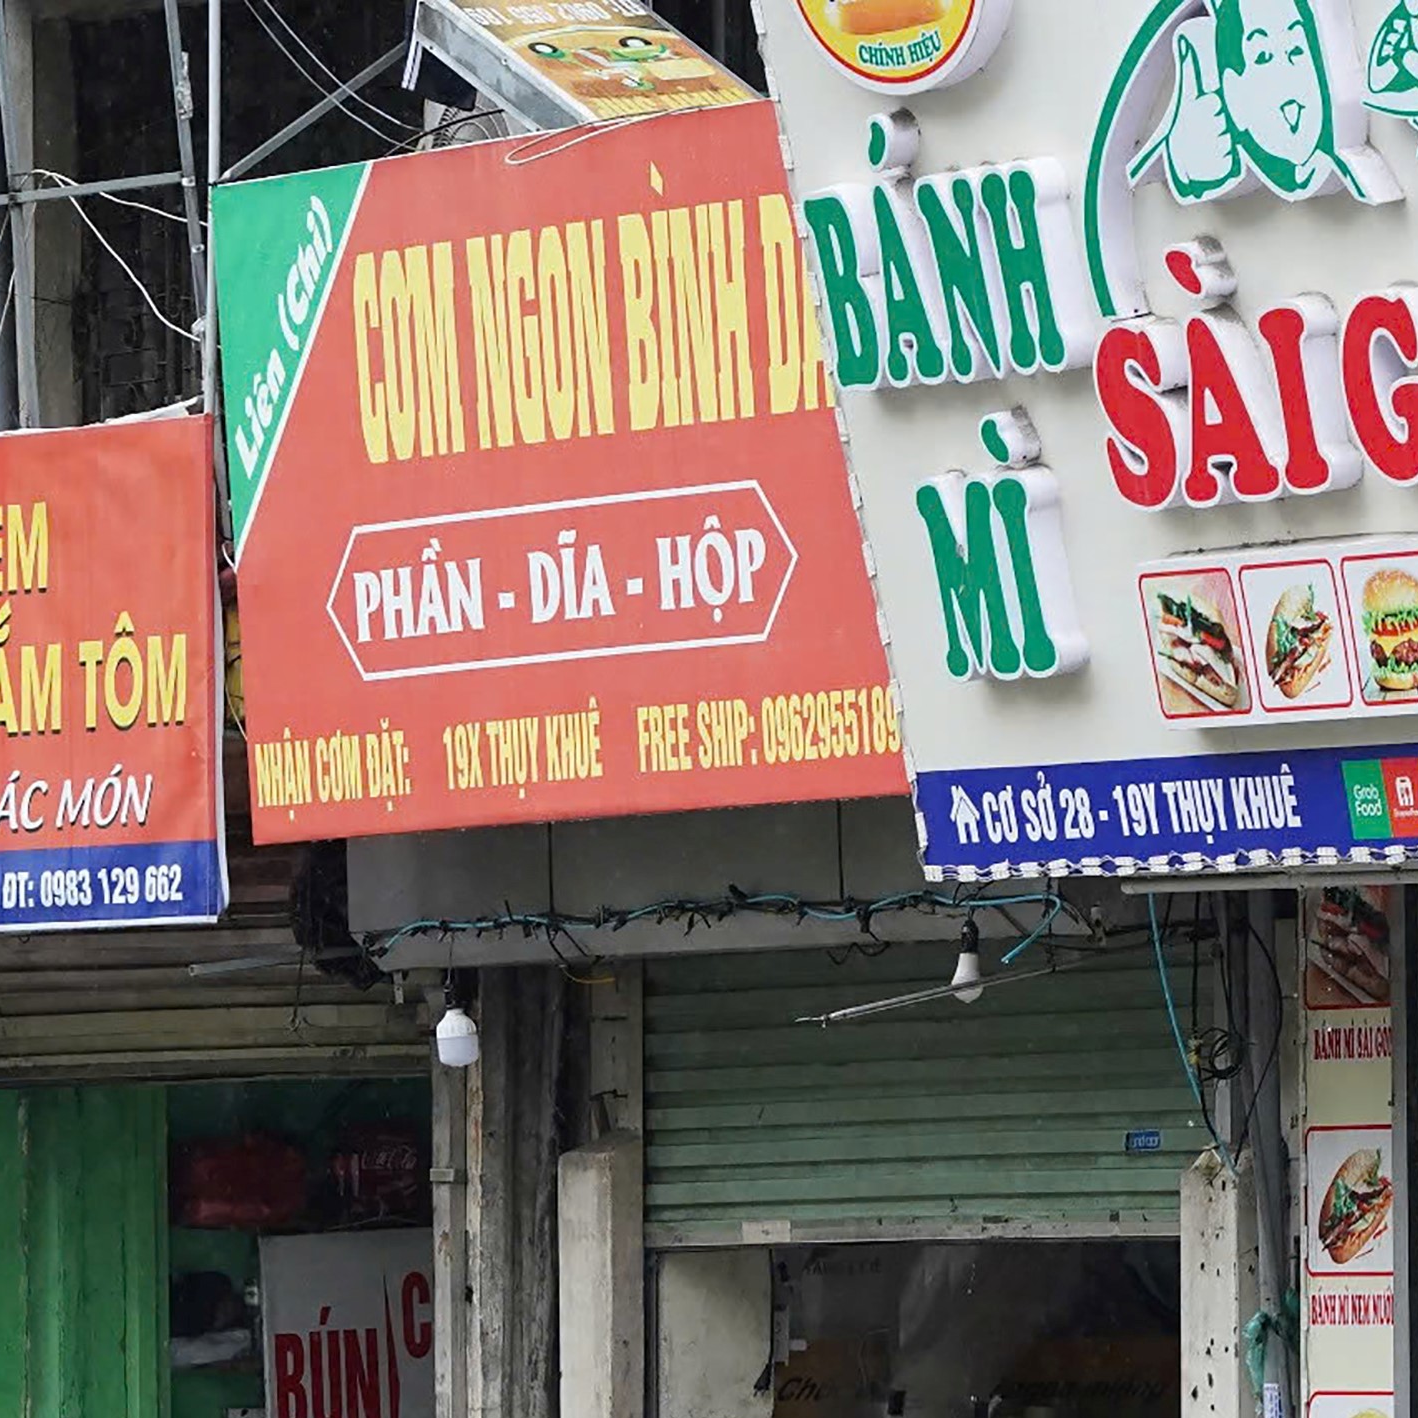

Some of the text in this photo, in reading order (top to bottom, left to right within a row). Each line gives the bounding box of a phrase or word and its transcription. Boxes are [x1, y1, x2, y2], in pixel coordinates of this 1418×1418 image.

[857, 31, 944, 69] CHÍNH HIỆU
[803, 119, 1067, 390] BÁNH
[353, 240, 465, 464] CƠM
[466, 220, 614, 451] NGON
[617, 160, 755, 431] BÌNH
[235, 348, 286, 479] Liên
[1096, 246, 1329, 510] SÀI
[353, 514, 766, 644] PHẦN DĨA HỘP
[916, 414, 1058, 681] MÌ
[79, 610, 187, 731] TÔM
[55, 764, 153, 828] MÓN
[254, 685, 901, 820] NHẬN CƠM ĐẶT: 19X THỤY KHUÊ FREE SHIP: 0962955189
[1353, 784, 1379, 800] Grab
[984, 763, 1302, 844] CƠ SỞ 28 19Y THỤY KHUÊ
[1355, 799, 1382, 817] Food
[3, 864, 183, 909] ĐT: 0983 129 662
[1314, 1019, 1341, 1060] BÁNH
[1344, 1017, 1355, 1058] MÌ
[1357, 1018, 1373, 1058] SÀI
[1312, 1285, 1370, 1325] BÁNH MÌ NEM
